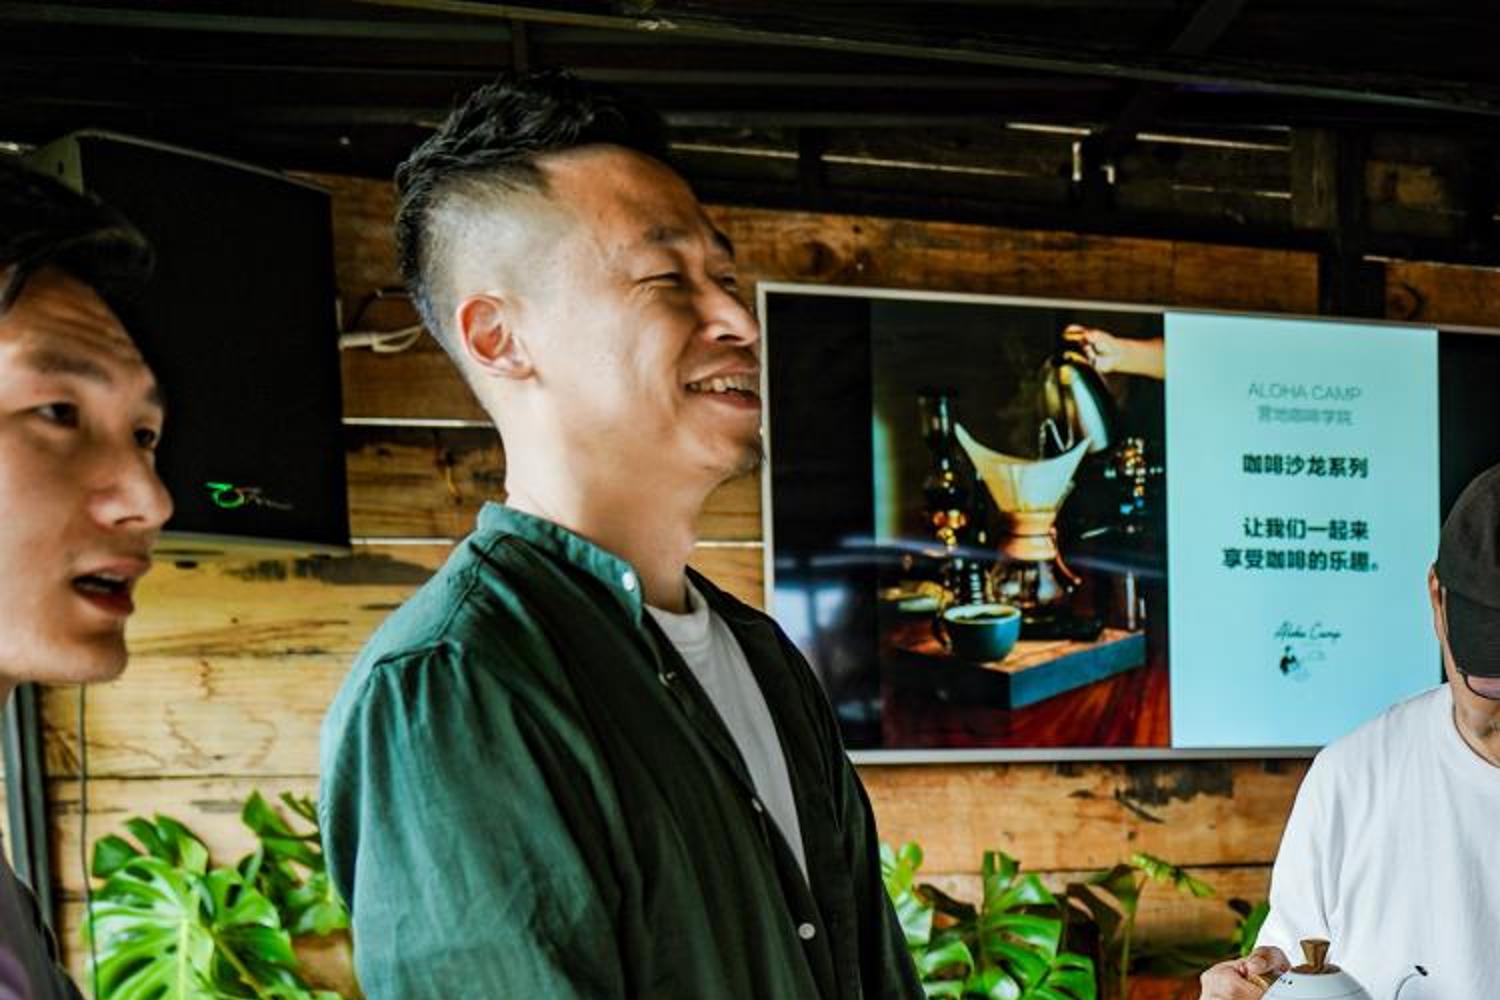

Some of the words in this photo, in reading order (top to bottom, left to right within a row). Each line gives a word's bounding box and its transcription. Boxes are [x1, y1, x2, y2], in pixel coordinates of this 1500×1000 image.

[1248, 383, 1307, 400] ALOHA
[1311, 385, 1362, 401] CAMP
[1242, 454, 1369, 479] 咖啡沙龙系列
[1243, 517, 1370, 541] 让我们一起来
